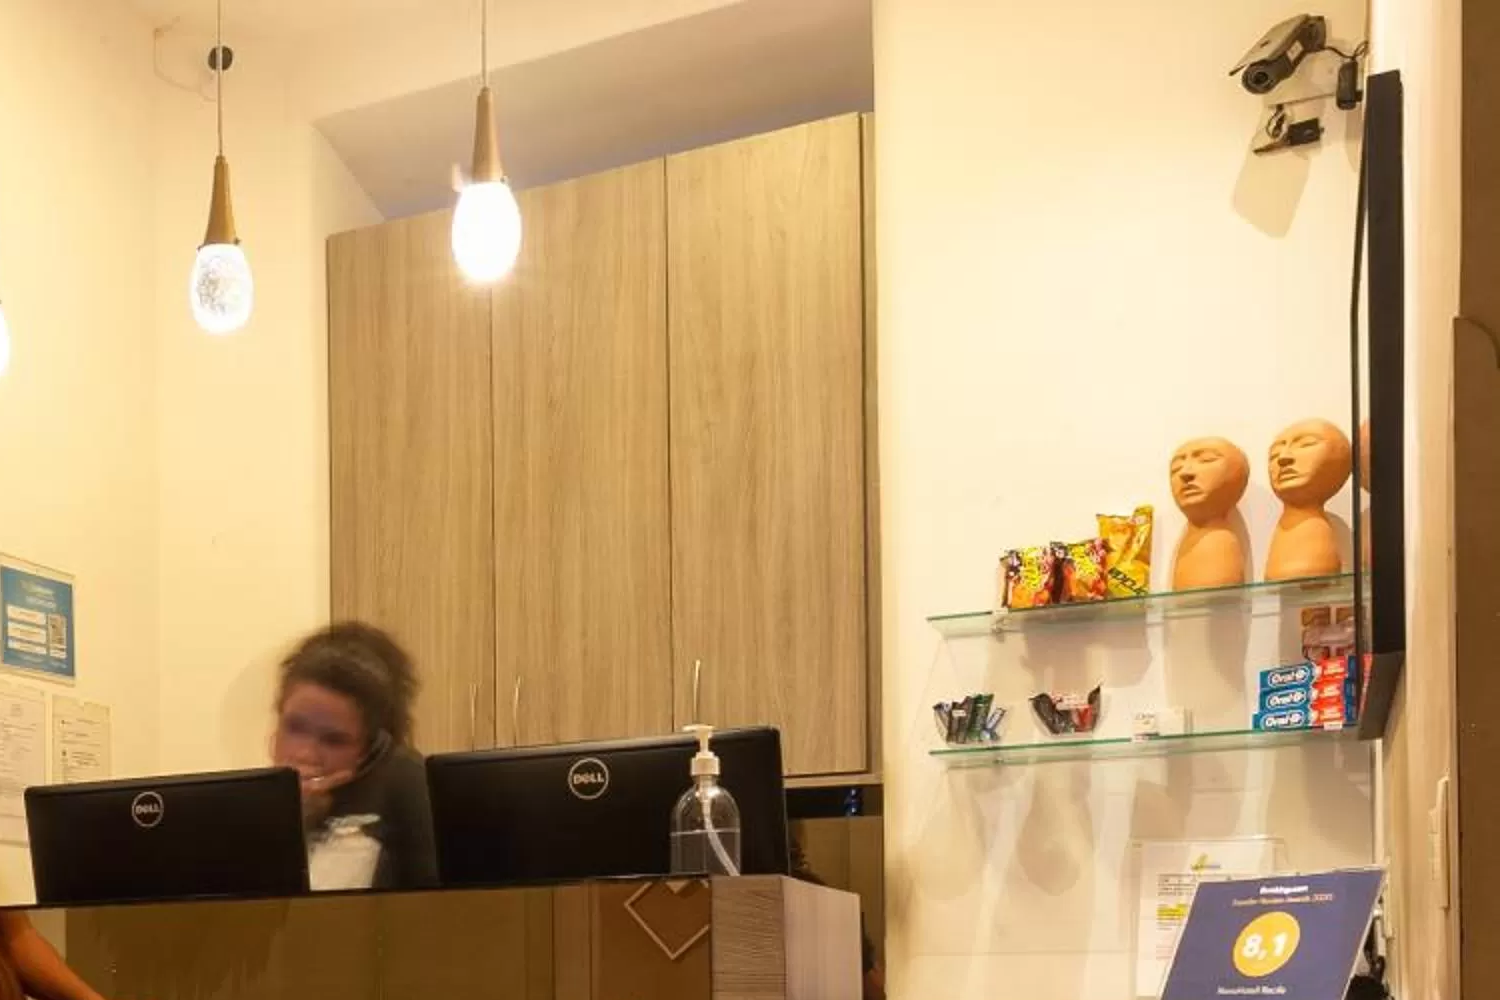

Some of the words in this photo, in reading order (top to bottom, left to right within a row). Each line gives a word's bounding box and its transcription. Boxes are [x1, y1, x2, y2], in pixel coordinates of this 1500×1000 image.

[573, 771, 605, 785] DELL
[135, 803, 161, 815] DELL
[1241, 931, 1289, 960] 8,1
